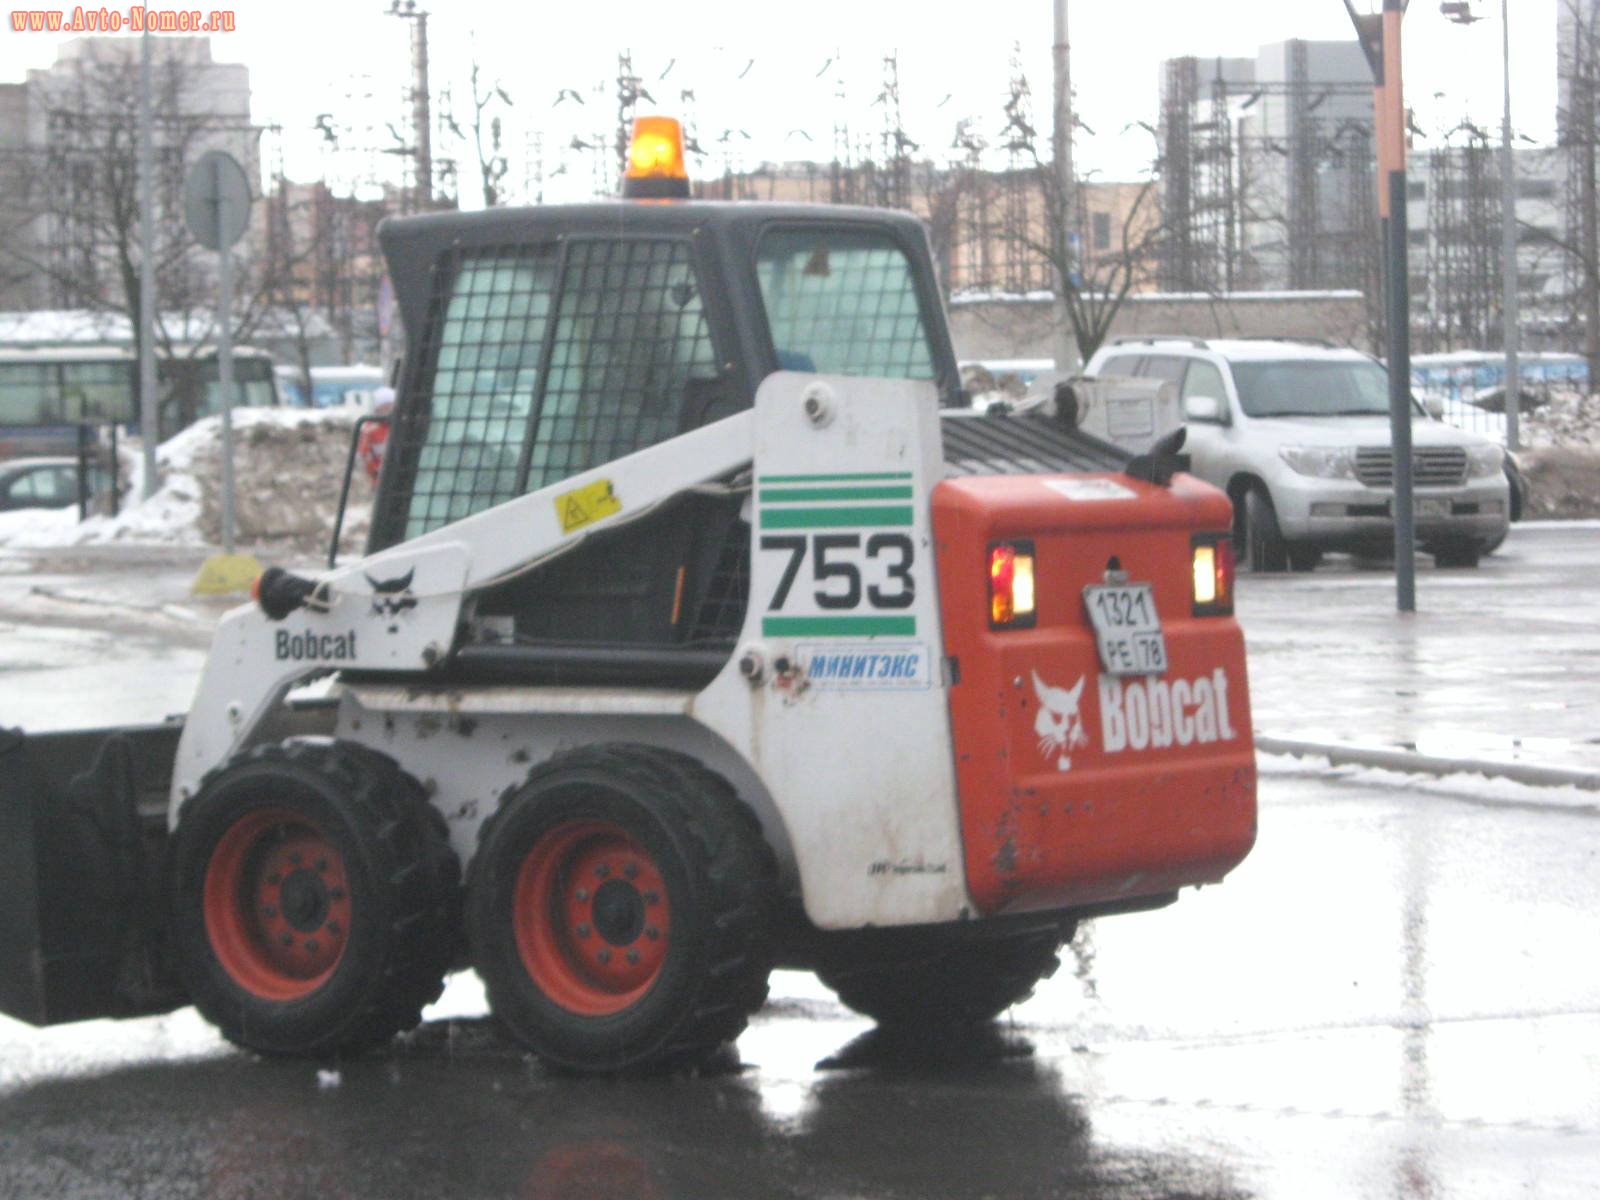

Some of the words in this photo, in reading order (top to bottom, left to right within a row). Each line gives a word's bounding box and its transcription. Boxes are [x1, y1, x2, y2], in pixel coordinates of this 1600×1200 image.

[760, 532, 915, 612] 753
[1097, 590, 1150, 627] 1321
[275, 627, 356, 660] Bobcat
[808, 654, 919, 678] МИНИТЭКС
[1099, 667, 1237, 752] Bobcat
